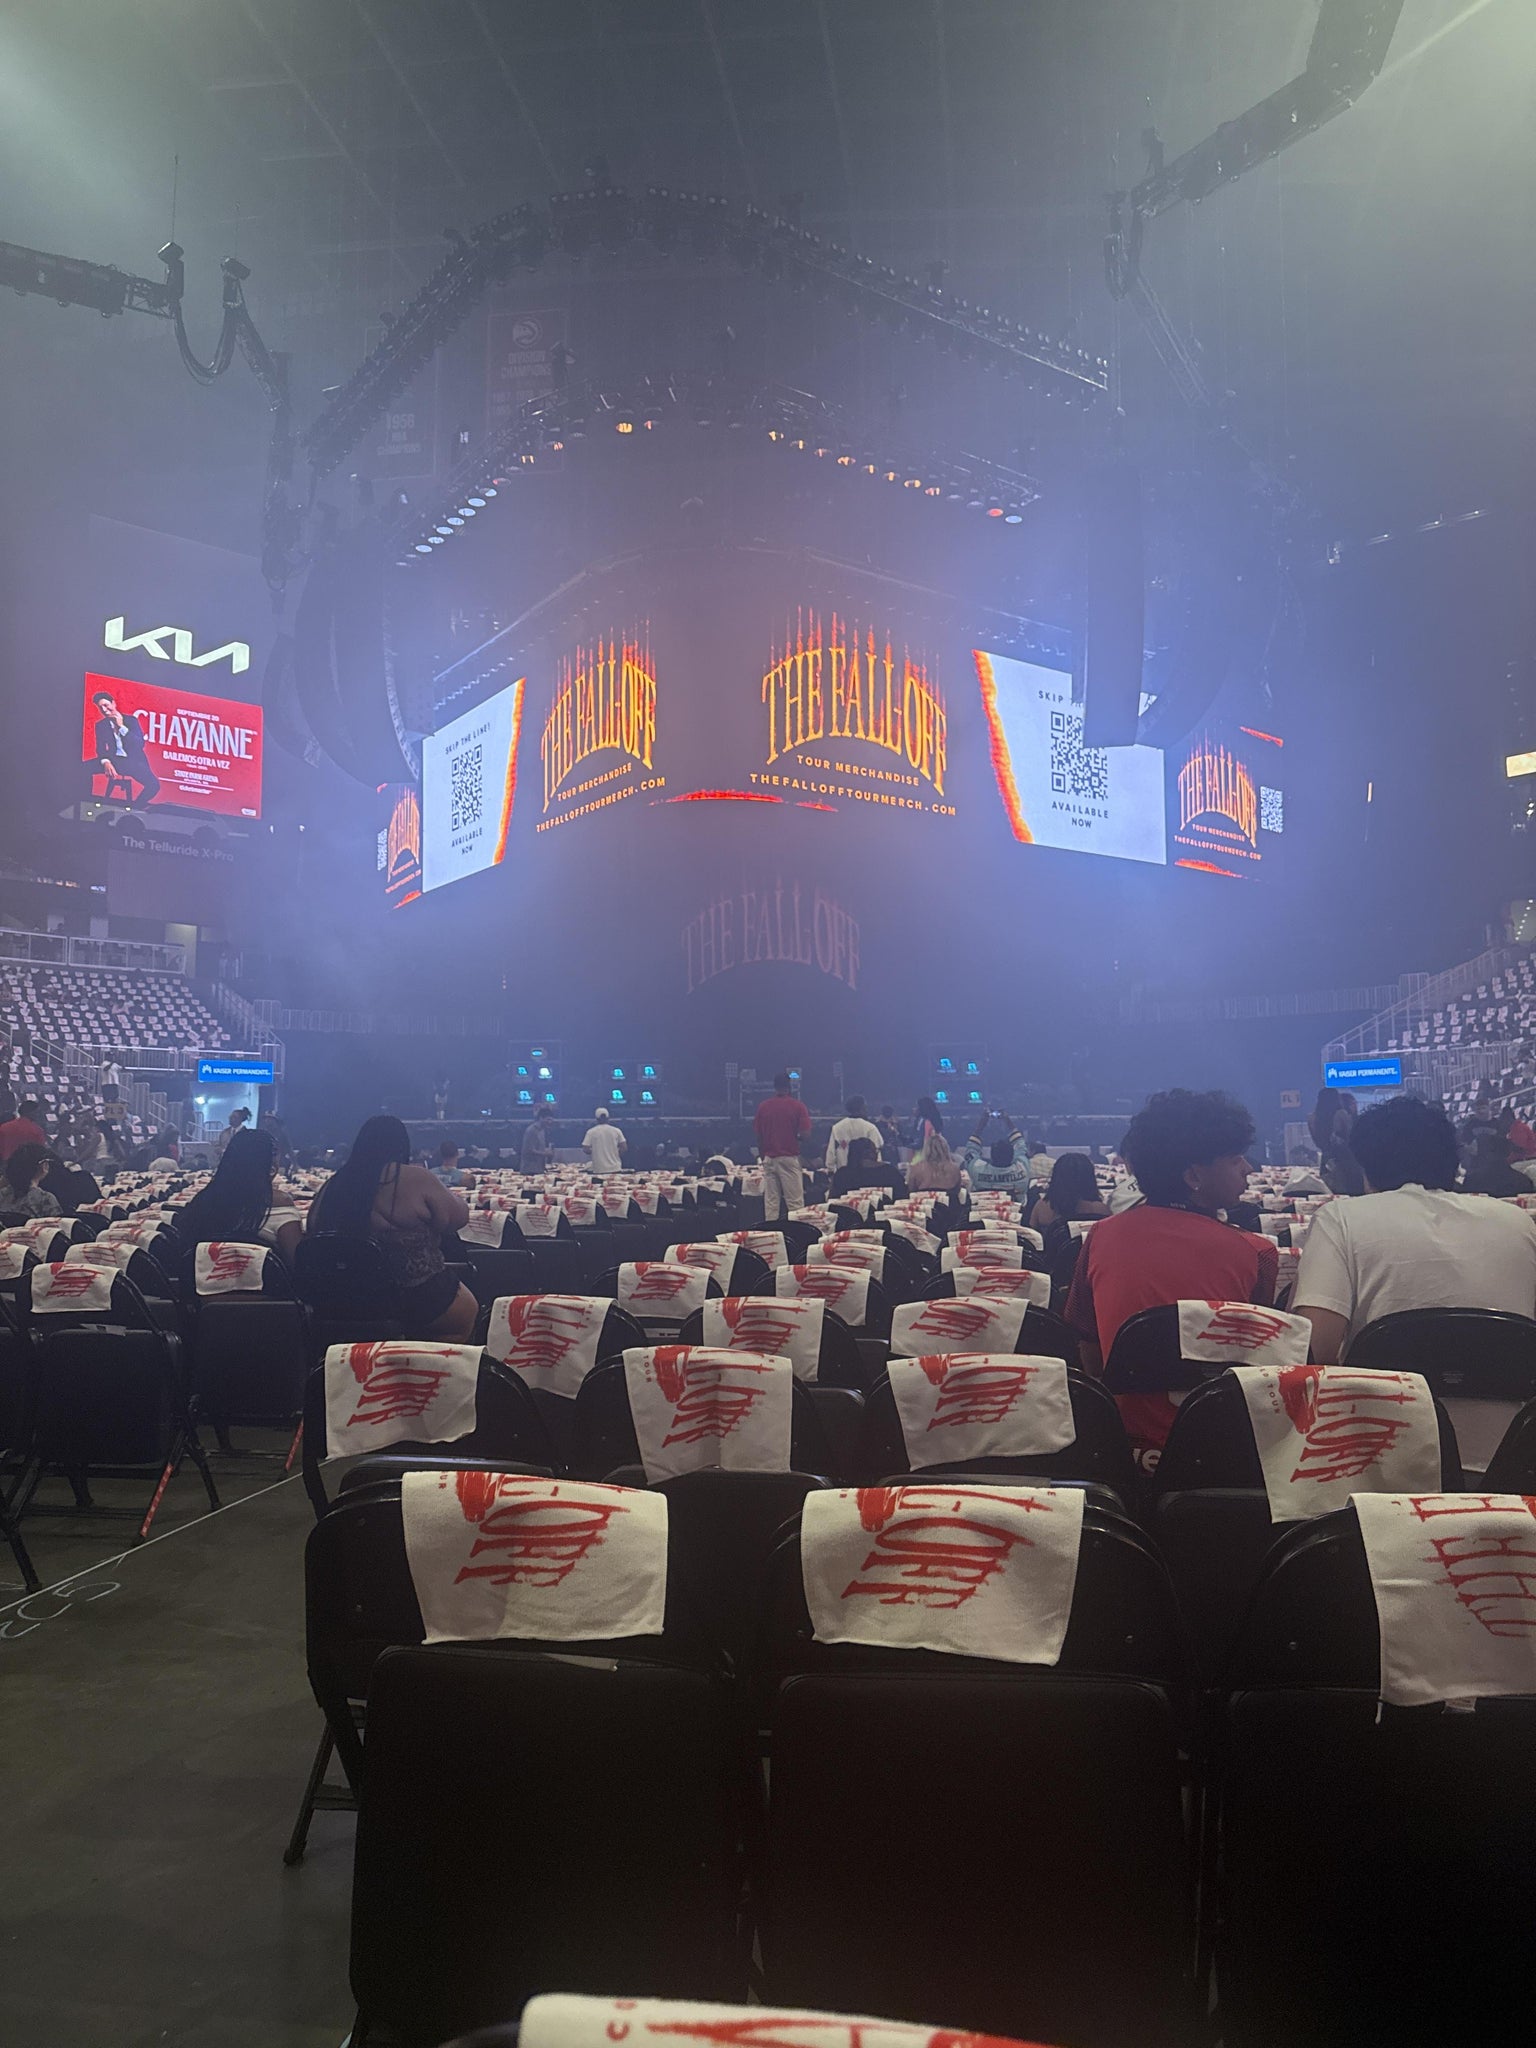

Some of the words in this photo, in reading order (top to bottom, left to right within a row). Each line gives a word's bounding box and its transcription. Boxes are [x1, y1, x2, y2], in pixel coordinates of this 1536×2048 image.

[761, 645, 824, 765] THE
[1038, 690, 1064, 703] SKIP
[445, 741, 460, 755] SKIP
[461, 733, 472, 746] THE
[796, 754, 831, 769] TOUR
[835, 762, 920, 786] MERCHANDISE
[557, 786, 577, 801] TOUR
[578, 762, 633, 793] MERCHANDISE
[1051, 801, 1110, 818] AVAILABLE
[1071, 817, 1093, 829] NOW
[122, 835, 146, 850] The
[148, 839, 200, 858] Telluride
[451, 827, 483, 848] AVAILABLE
